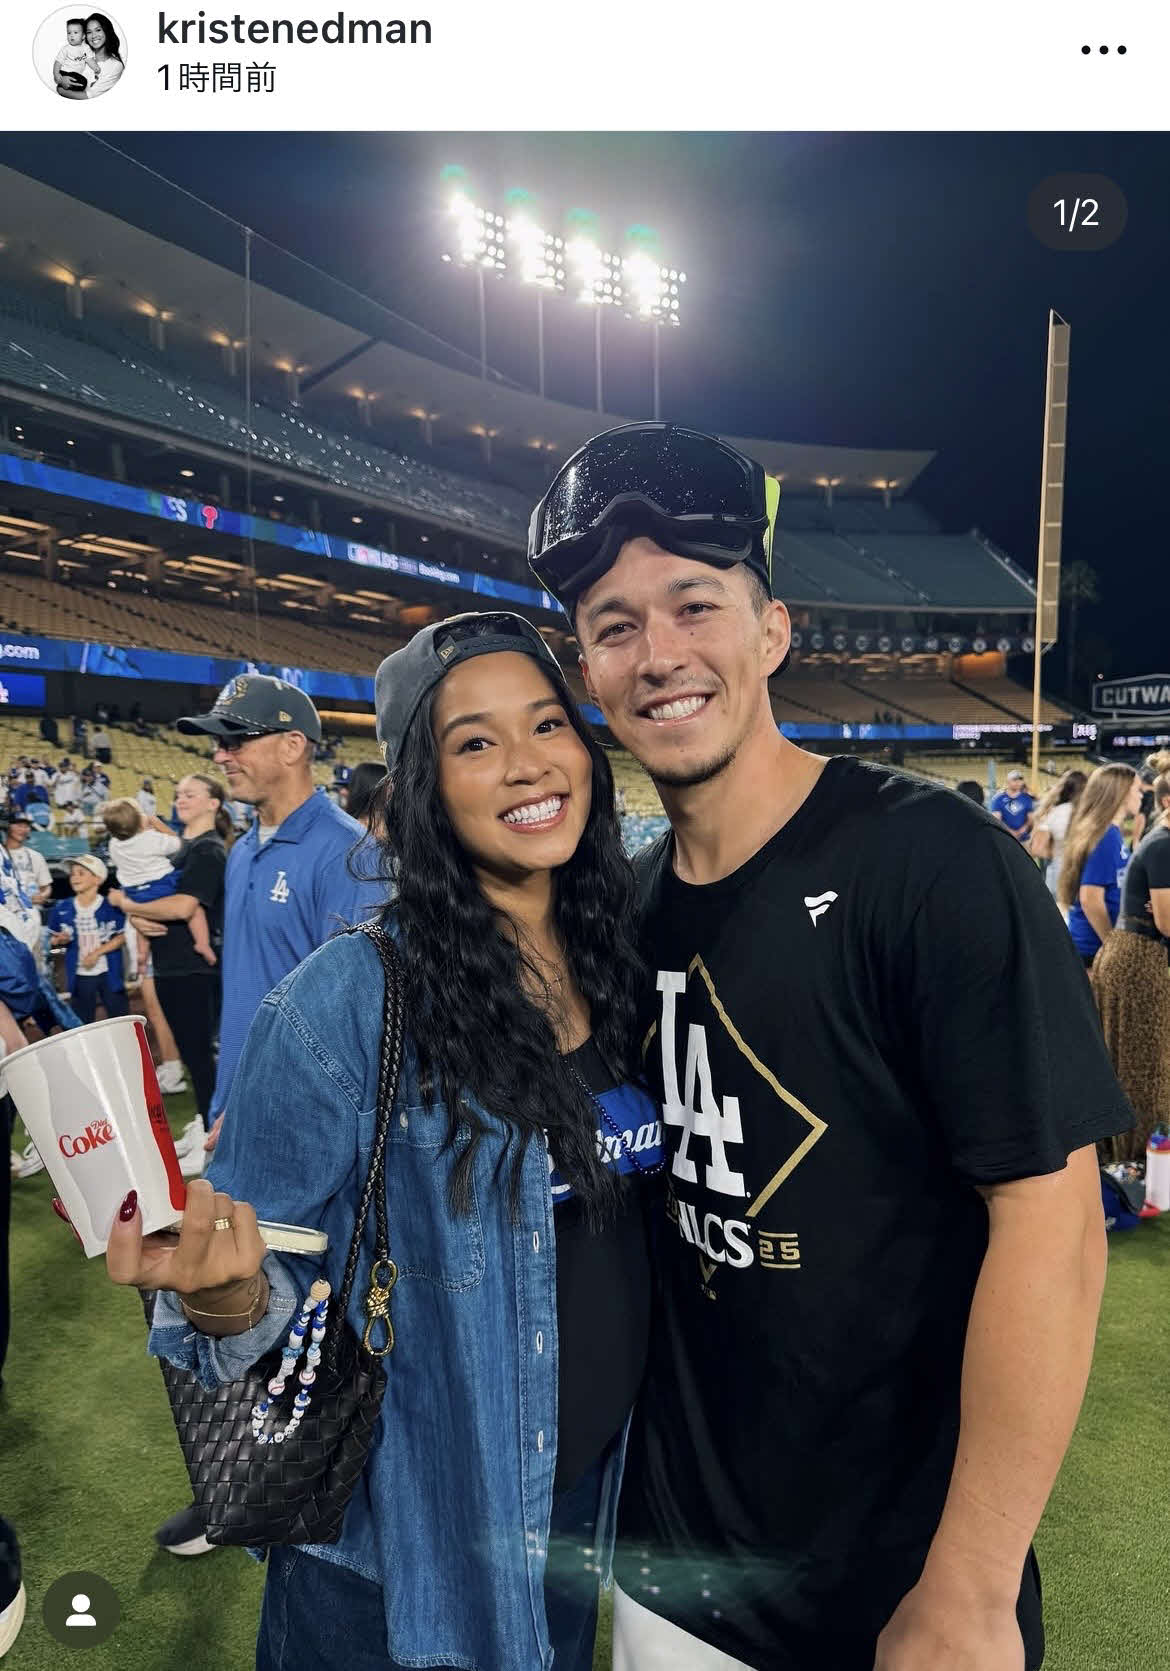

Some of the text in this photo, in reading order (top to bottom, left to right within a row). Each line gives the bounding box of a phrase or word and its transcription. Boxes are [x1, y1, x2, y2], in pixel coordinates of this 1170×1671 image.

[270, 871, 290, 903] LA
[656, 970, 747, 1198] LA
[59, 1124, 114, 1158] Coke
[758, 1238, 801, 1261] 25
